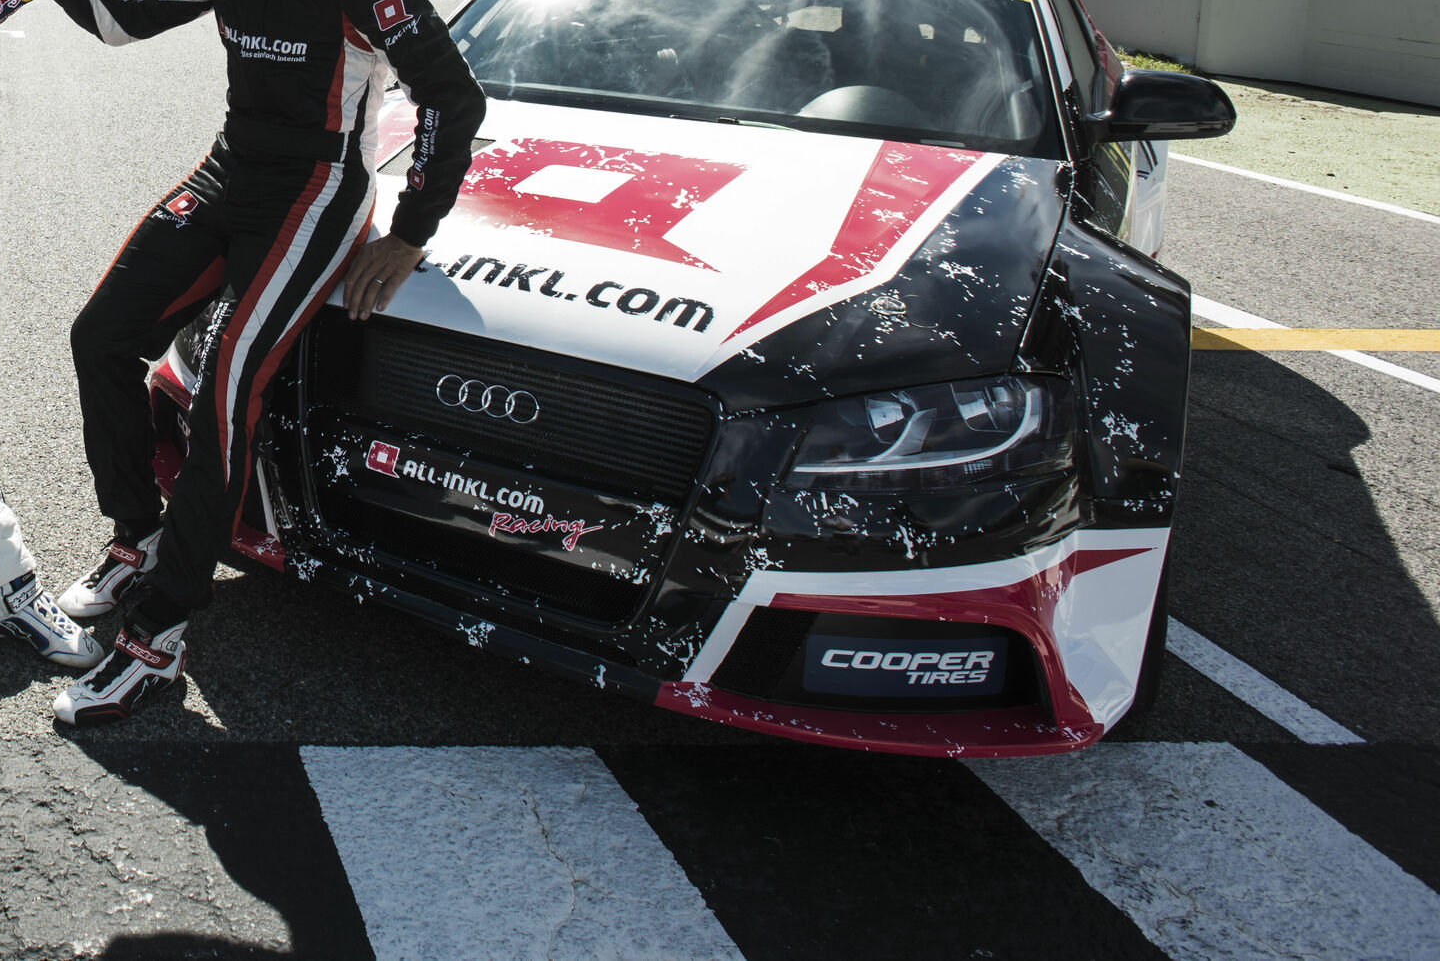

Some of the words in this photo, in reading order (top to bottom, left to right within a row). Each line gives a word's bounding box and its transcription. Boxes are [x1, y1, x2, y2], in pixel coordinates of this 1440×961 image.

[384, 15, 422, 50] Racing
[488, 511, 604, 551] Racing
[821, 648, 995, 671] COOPER
[906, 669, 989, 685] TIRES
